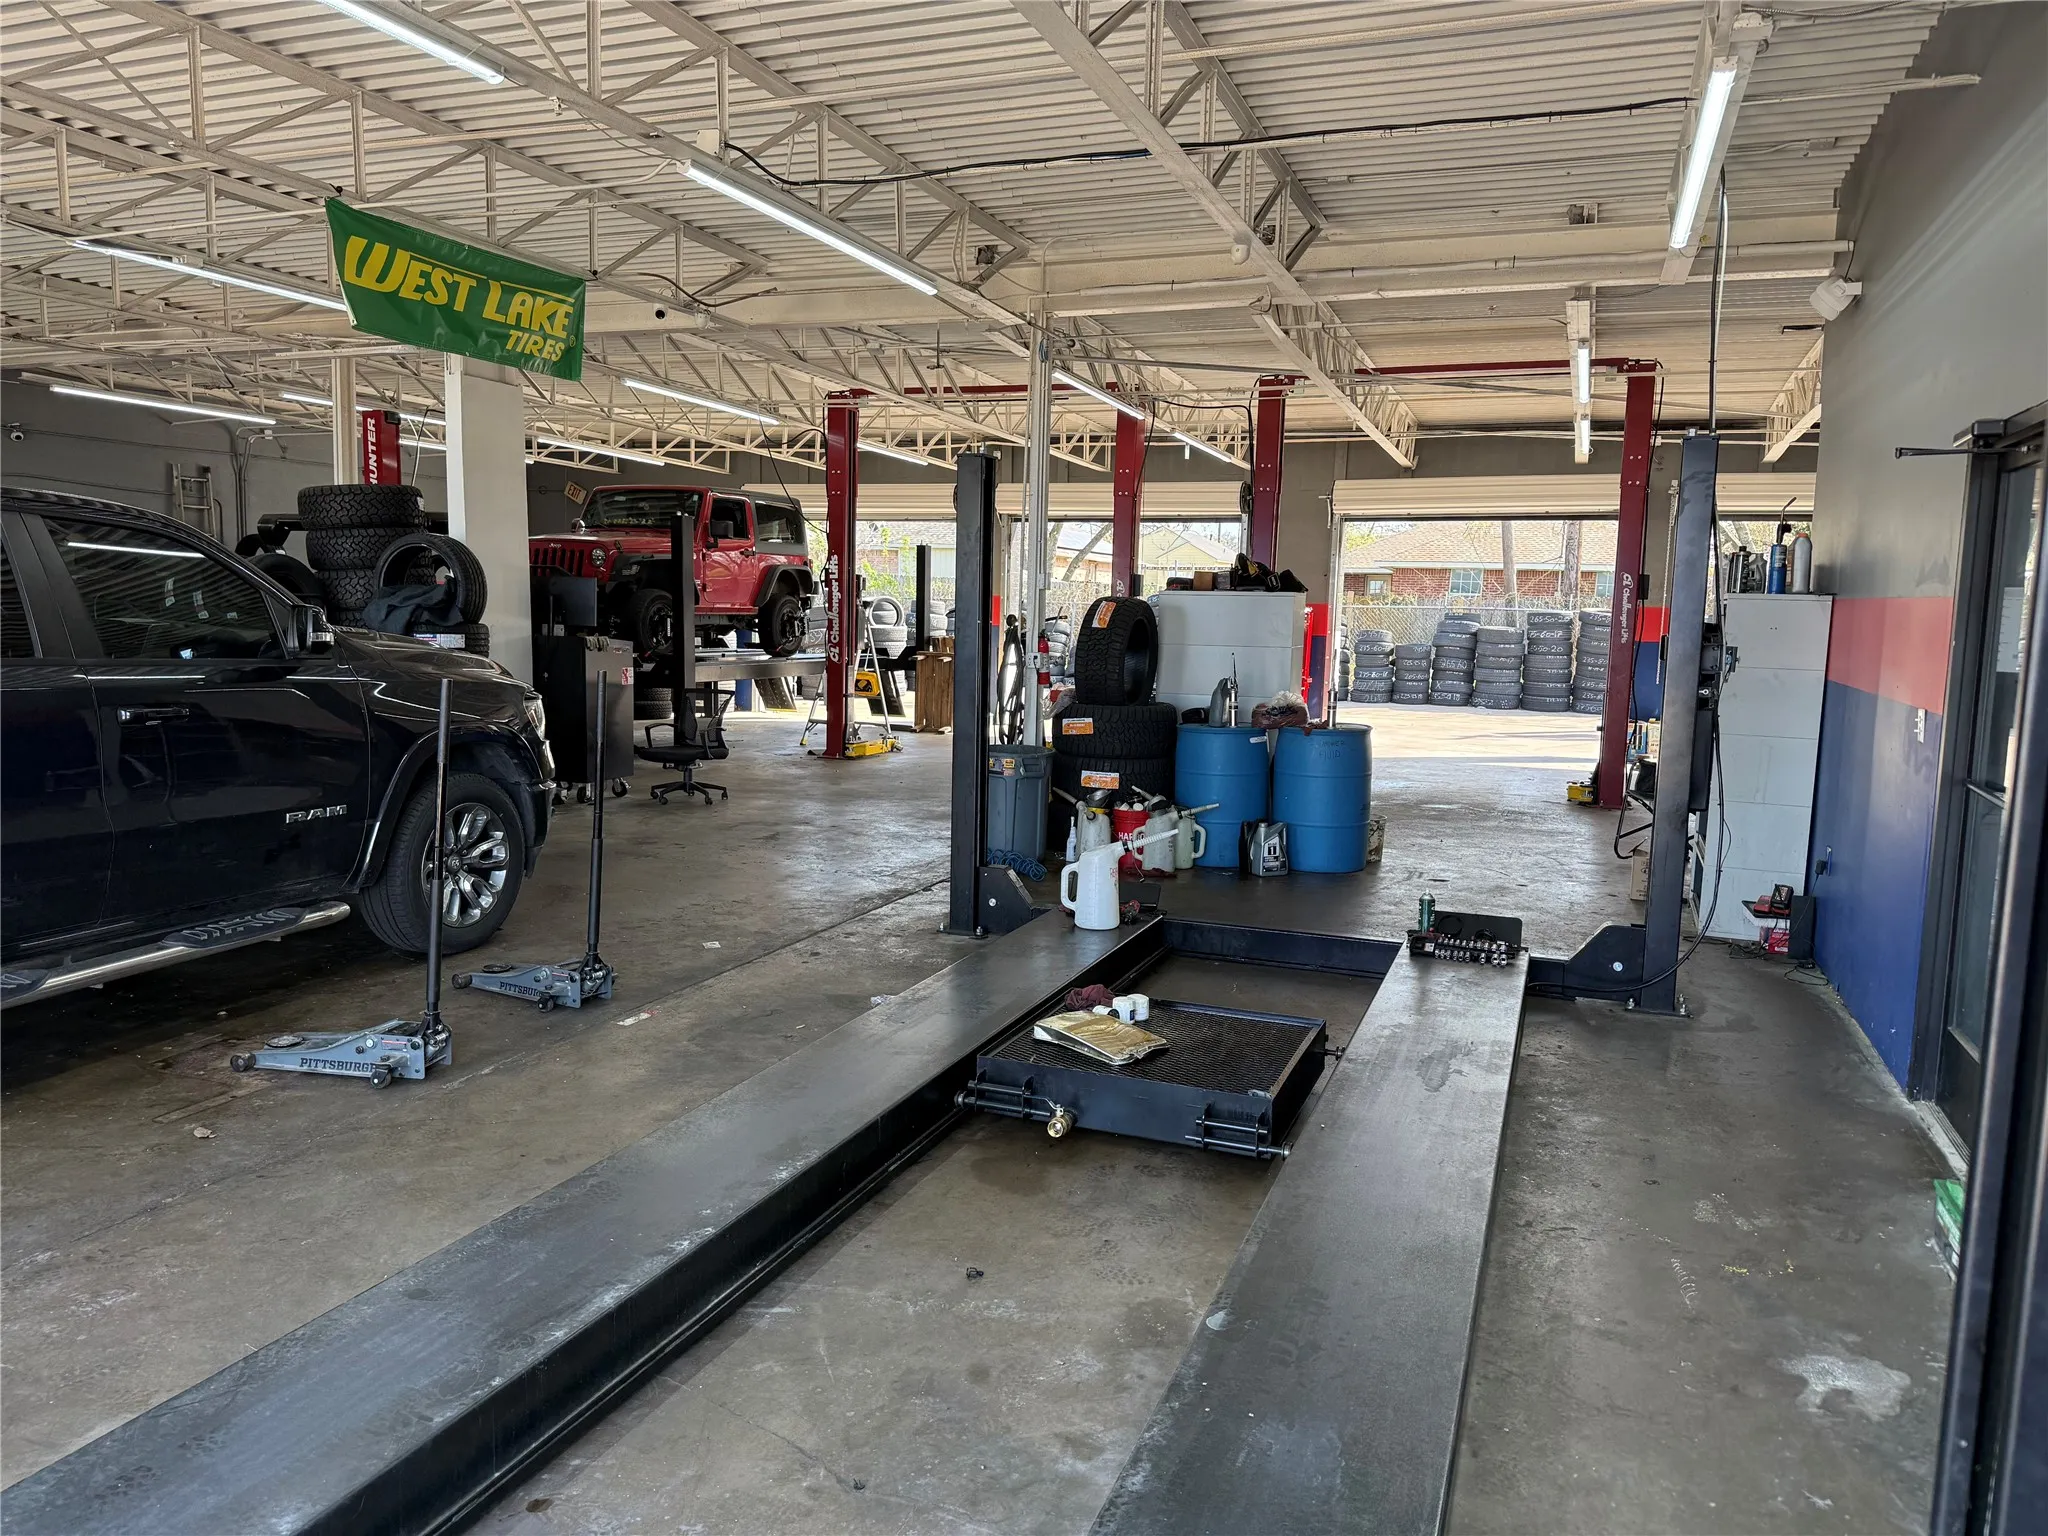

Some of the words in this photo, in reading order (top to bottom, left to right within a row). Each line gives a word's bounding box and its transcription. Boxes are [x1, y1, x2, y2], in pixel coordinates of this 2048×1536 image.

[344, 236, 476, 312] WEST
[482, 279, 574, 338] LAKE
[505, 329, 565, 362] TIRES
[567, 484, 582, 500] EXIT
[829, 554, 839, 579] Lifts
[828, 579, 841, 644] Challenger
[286, 805, 347, 823] RAM
